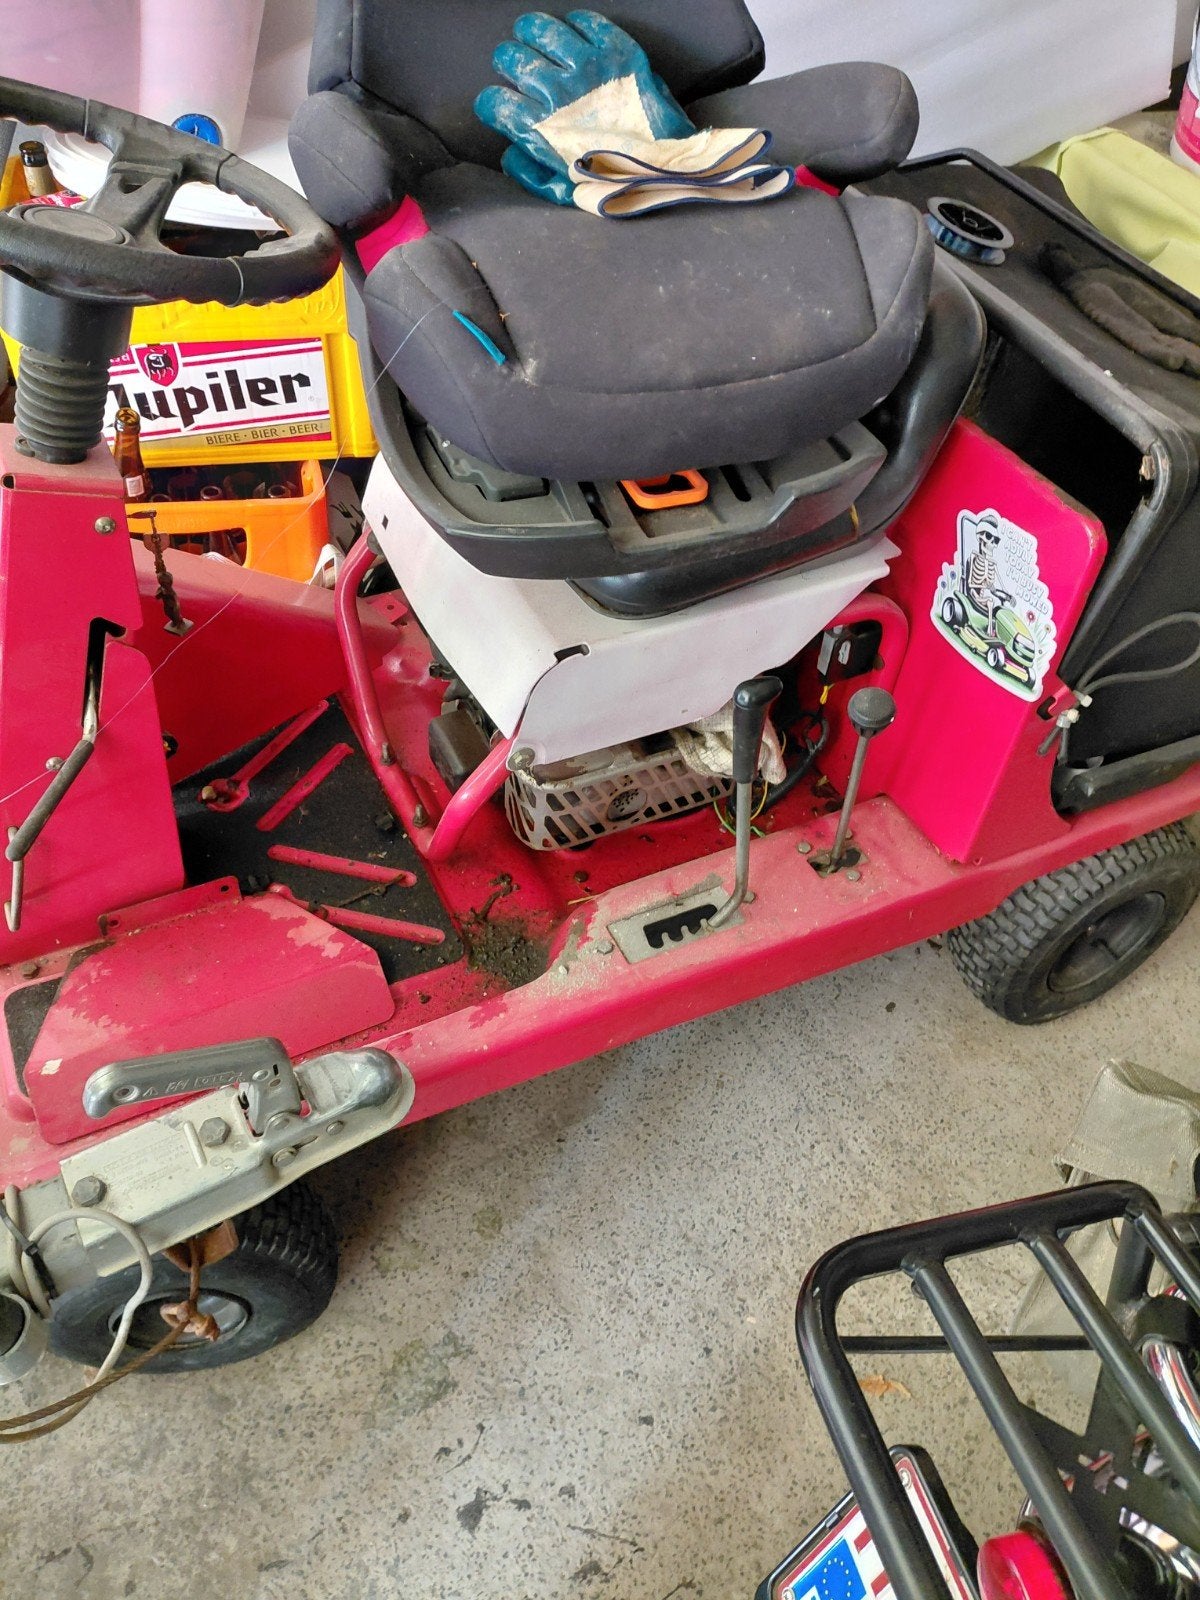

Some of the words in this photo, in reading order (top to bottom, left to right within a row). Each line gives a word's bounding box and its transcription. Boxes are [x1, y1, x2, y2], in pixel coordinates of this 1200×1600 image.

[205, 433, 241, 446] BIERE
[250, 428, 278, 440] BIER
[289, 423, 320, 434] BEER
[1006, 527, 1033, 552] CAN'T
[1004, 541, 1033, 565] ADULT
[1005, 552, 1036, 579] TODAY
[1019, 577, 1045, 598] BUSY
